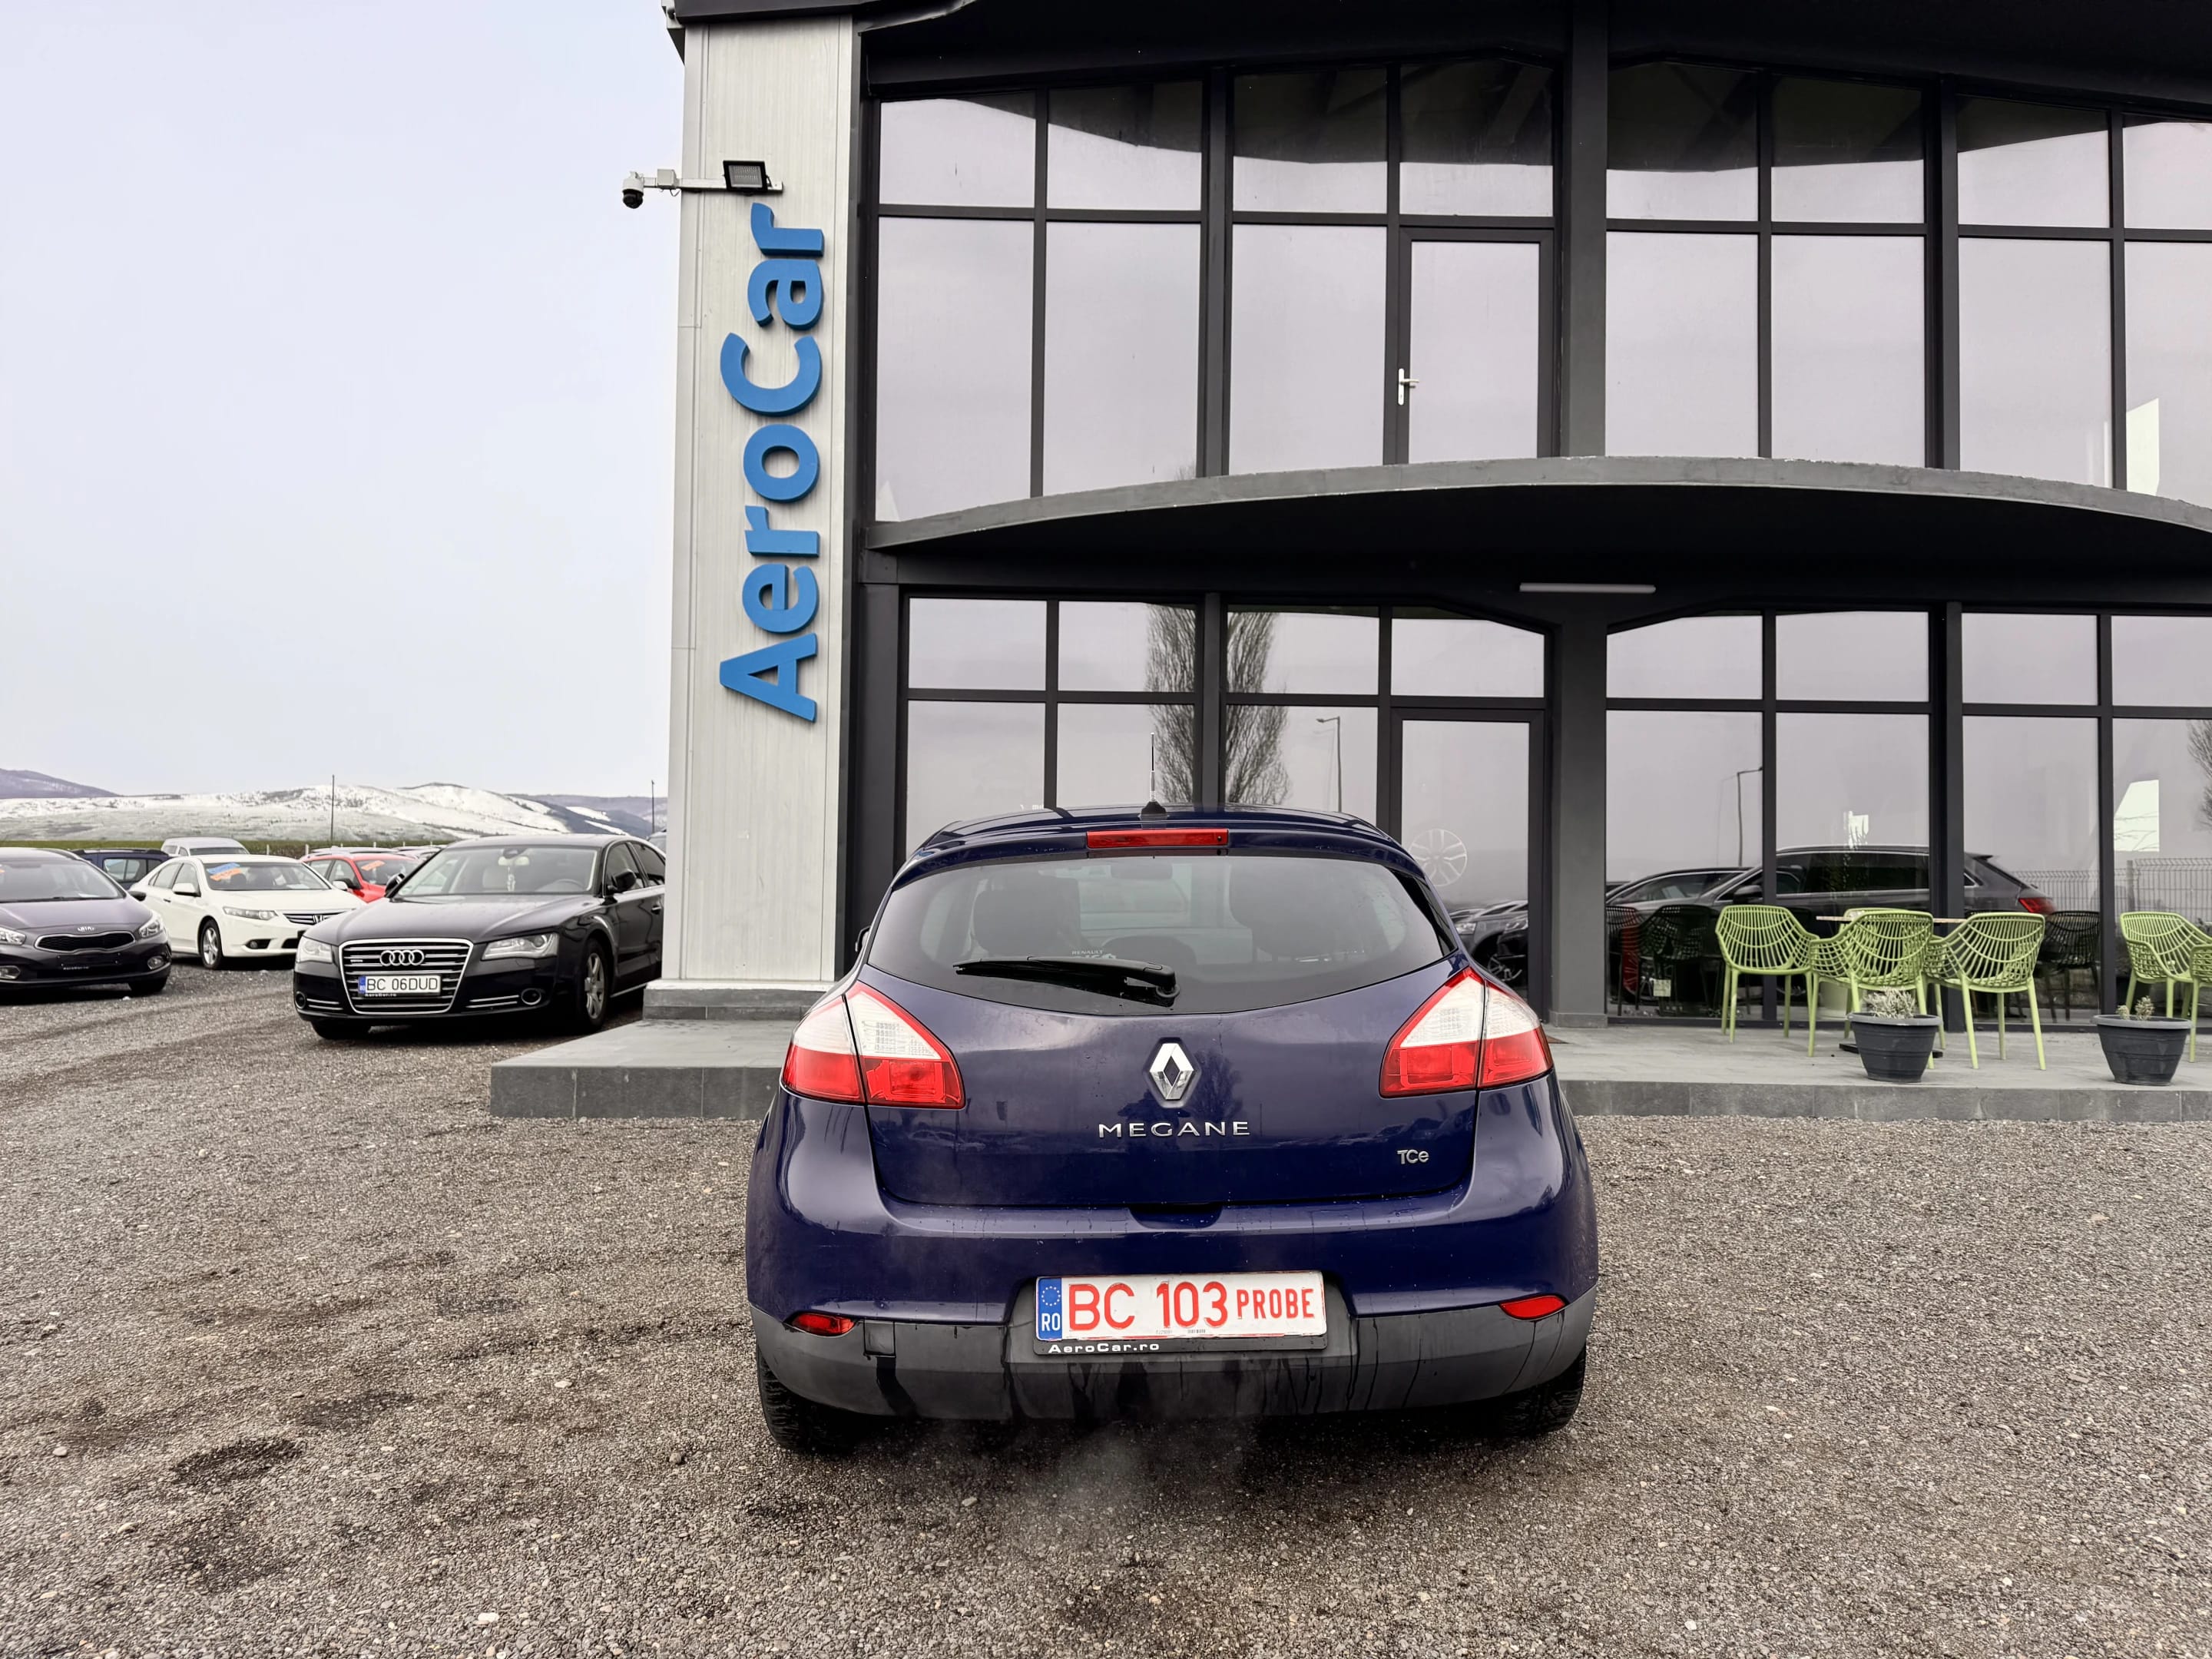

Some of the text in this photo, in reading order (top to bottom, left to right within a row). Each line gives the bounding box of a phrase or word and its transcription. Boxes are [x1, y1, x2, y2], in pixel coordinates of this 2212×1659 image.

[720, 202, 825, 724] AeroCar
[367, 978, 386, 991] BC
[392, 977, 438, 991] 06DUD
[1098, 1121, 1250, 1138] MEGANE
[1396, 1149, 1429, 1165] TCe
[1041, 1280, 1315, 1332] RO BC 103 PROBE
[1048, 1342, 1161, 1354] AeroCar.ro
